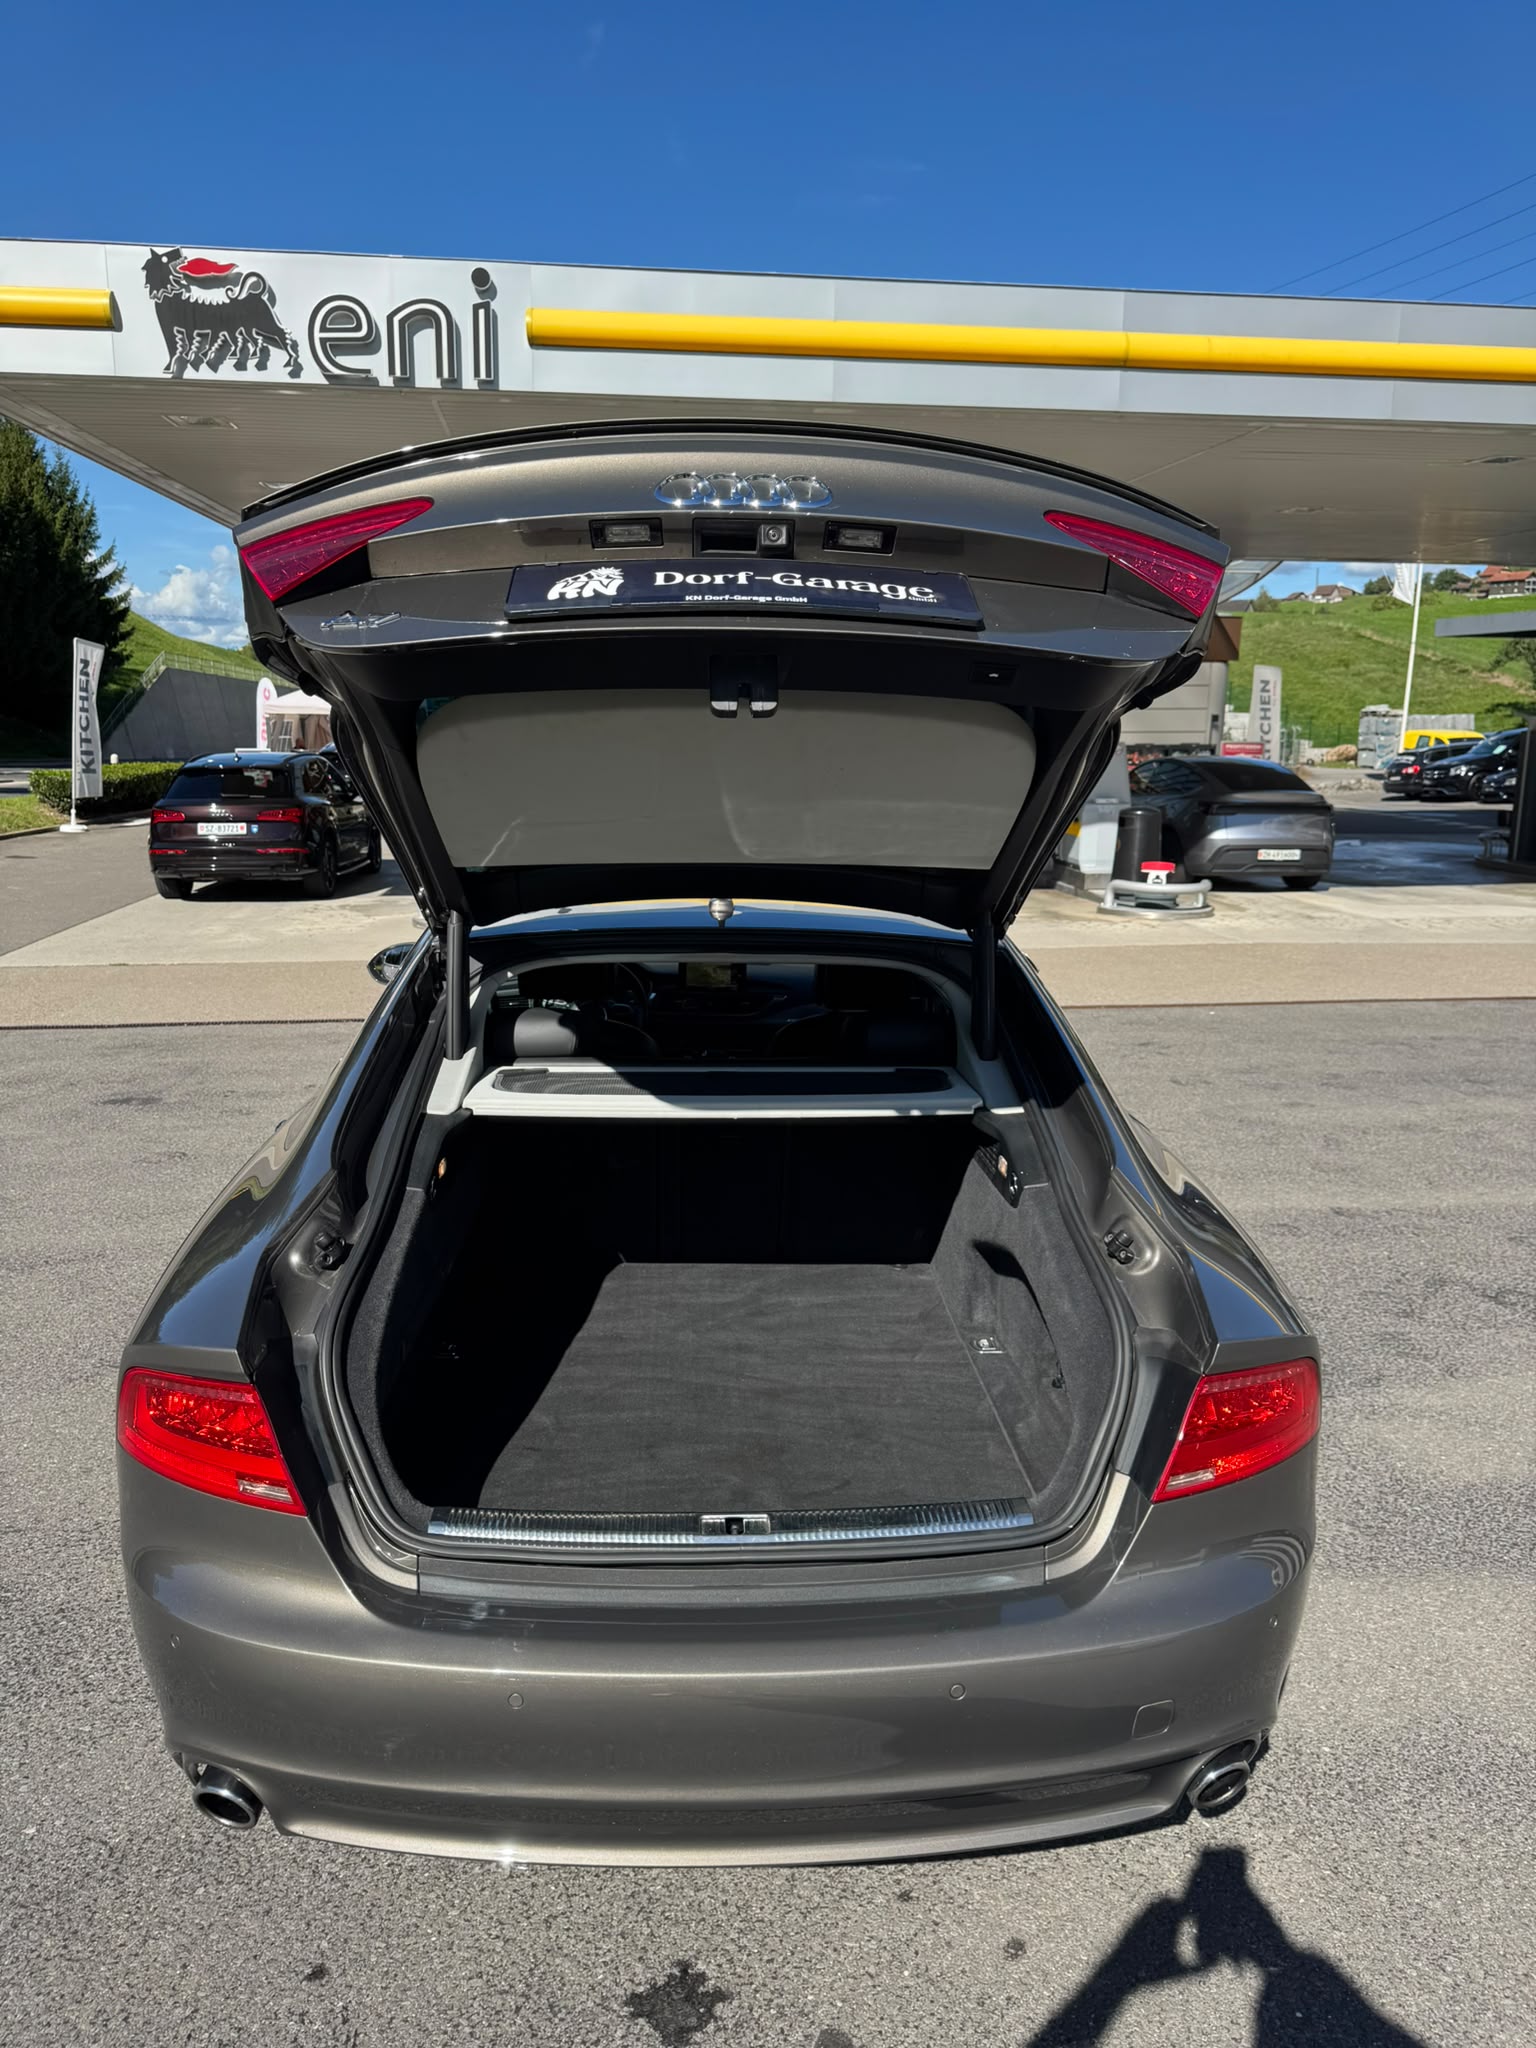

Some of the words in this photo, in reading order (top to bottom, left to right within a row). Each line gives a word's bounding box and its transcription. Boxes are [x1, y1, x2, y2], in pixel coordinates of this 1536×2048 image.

[308, 267, 493, 380] eni
[654, 571, 935, 599] Dorf-Garage
[704, 594, 773, 602] Dorf-Garage
[79, 658, 97, 775] KITCHEN
